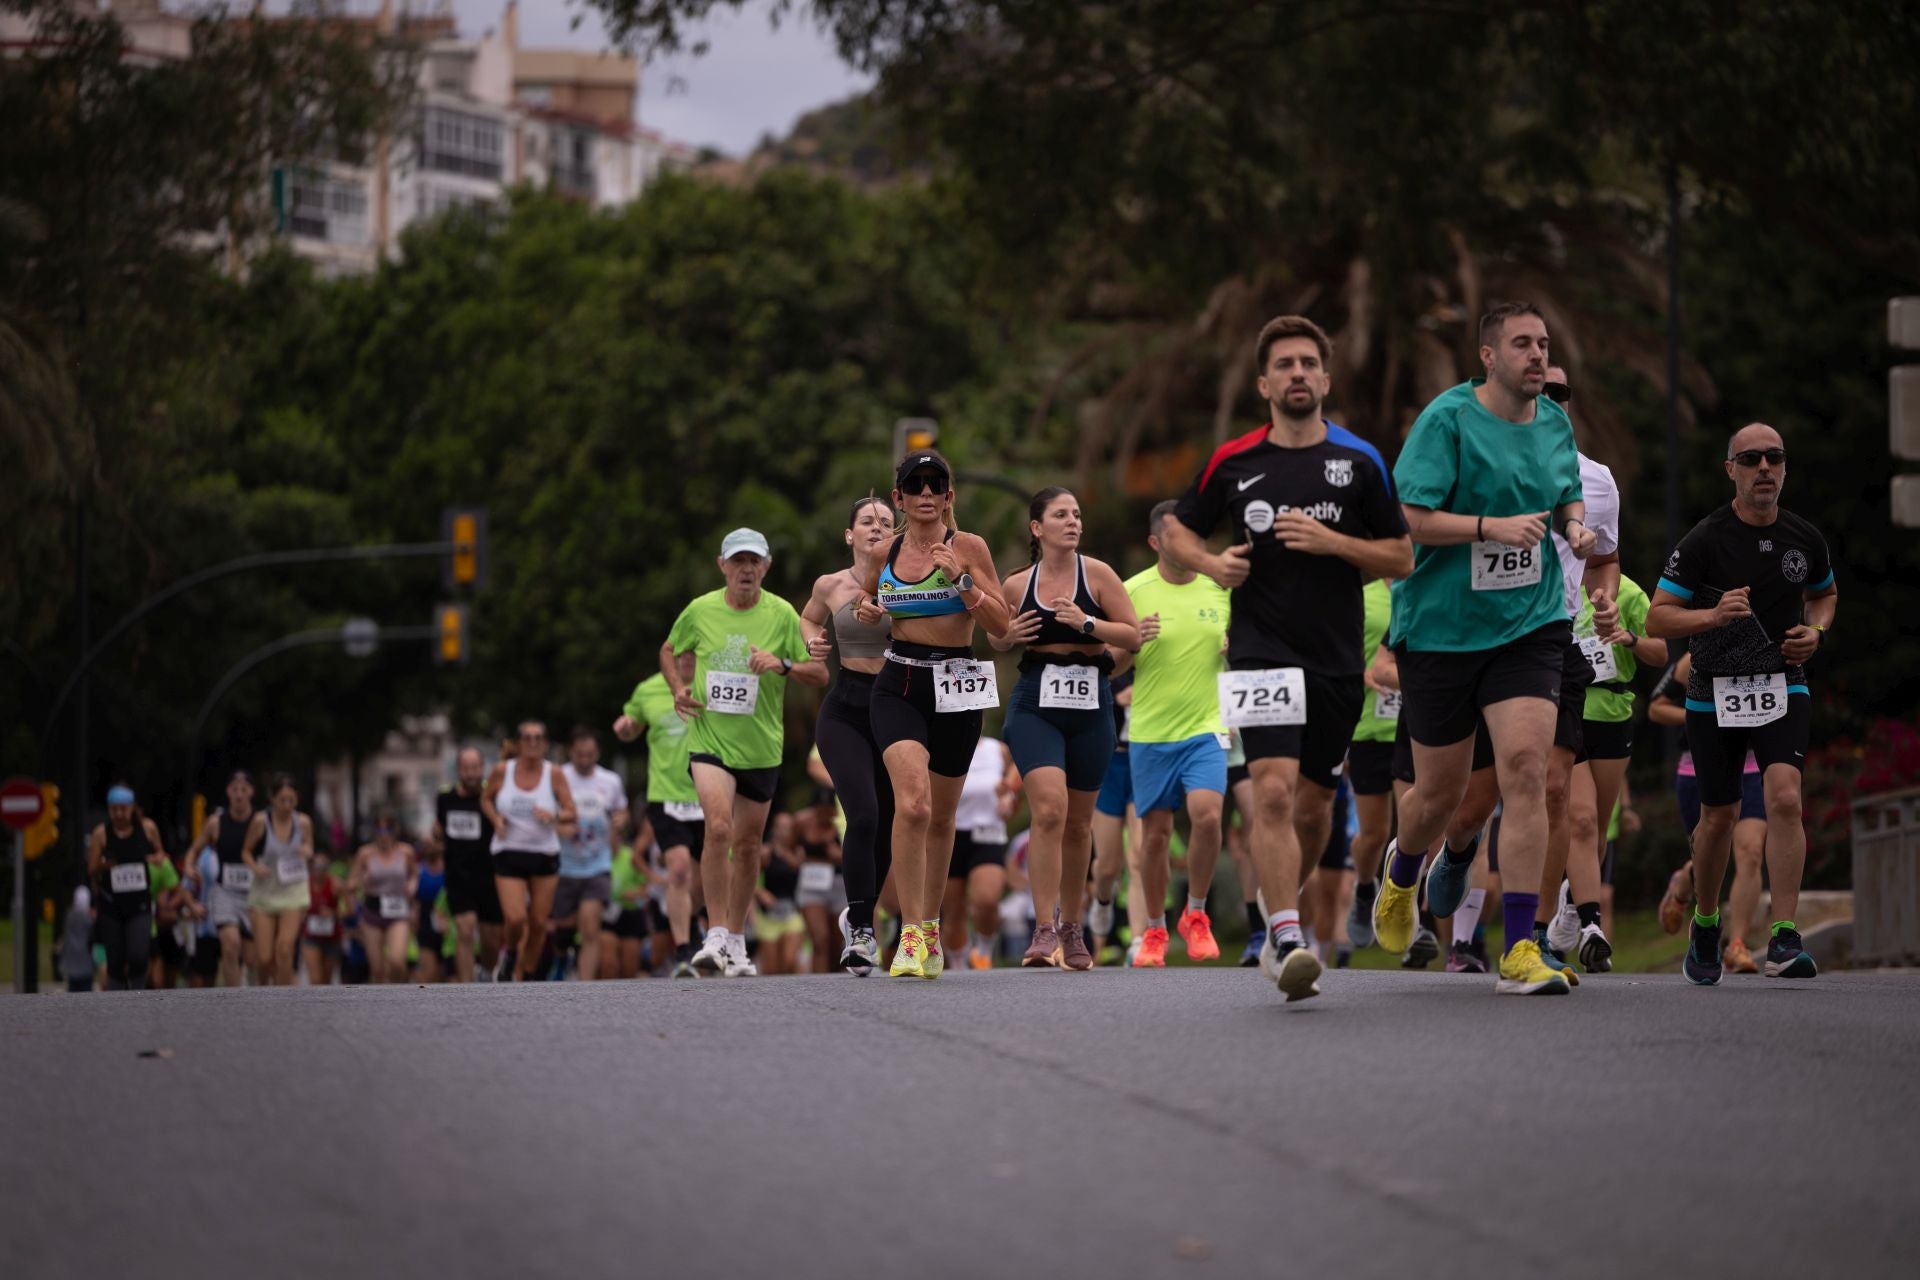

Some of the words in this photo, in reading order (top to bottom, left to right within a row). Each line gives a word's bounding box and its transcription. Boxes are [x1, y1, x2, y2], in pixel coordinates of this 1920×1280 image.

[1278, 501, 1342, 522] Sotify
[1484, 550, 1532, 573] 768
[882, 591, 950, 602] TORREMOLINOS
[711, 685, 748, 702] 832
[940, 678, 988, 694] 1137
[1050, 679, 1089, 695] 116
[1231, 687, 1291, 708] 724
[1725, 692, 1777, 712] 318
